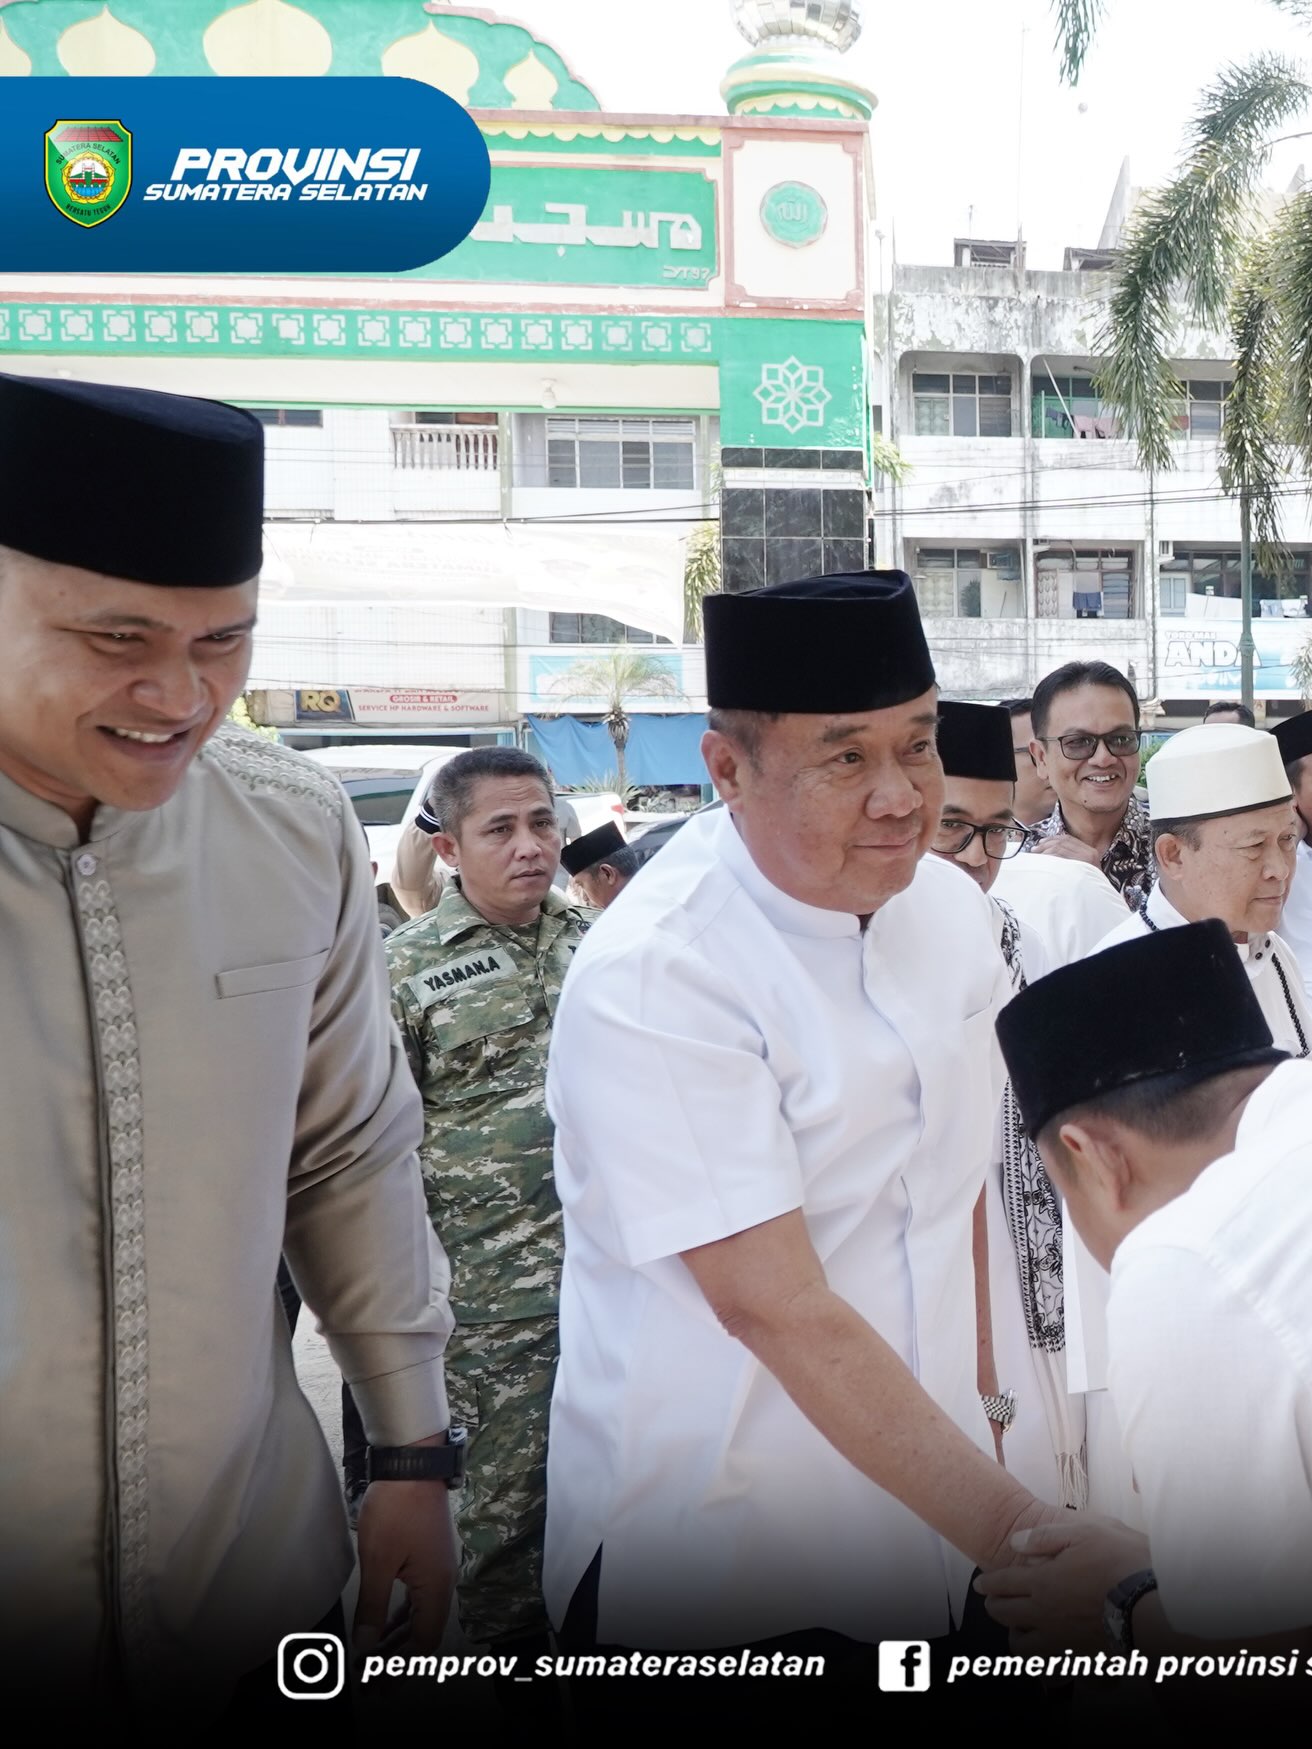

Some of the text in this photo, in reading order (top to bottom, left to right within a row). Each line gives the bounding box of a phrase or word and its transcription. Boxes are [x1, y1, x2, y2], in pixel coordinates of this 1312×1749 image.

[301, 689, 342, 713] RQ
[358, 704, 387, 712] SERVICE
[389, 704, 399, 712] HP
[401, 704, 442, 712] HARDWARE
[451, 704, 489, 712] SOFTWARE
[423, 956, 500, 992] YASMAN.A
